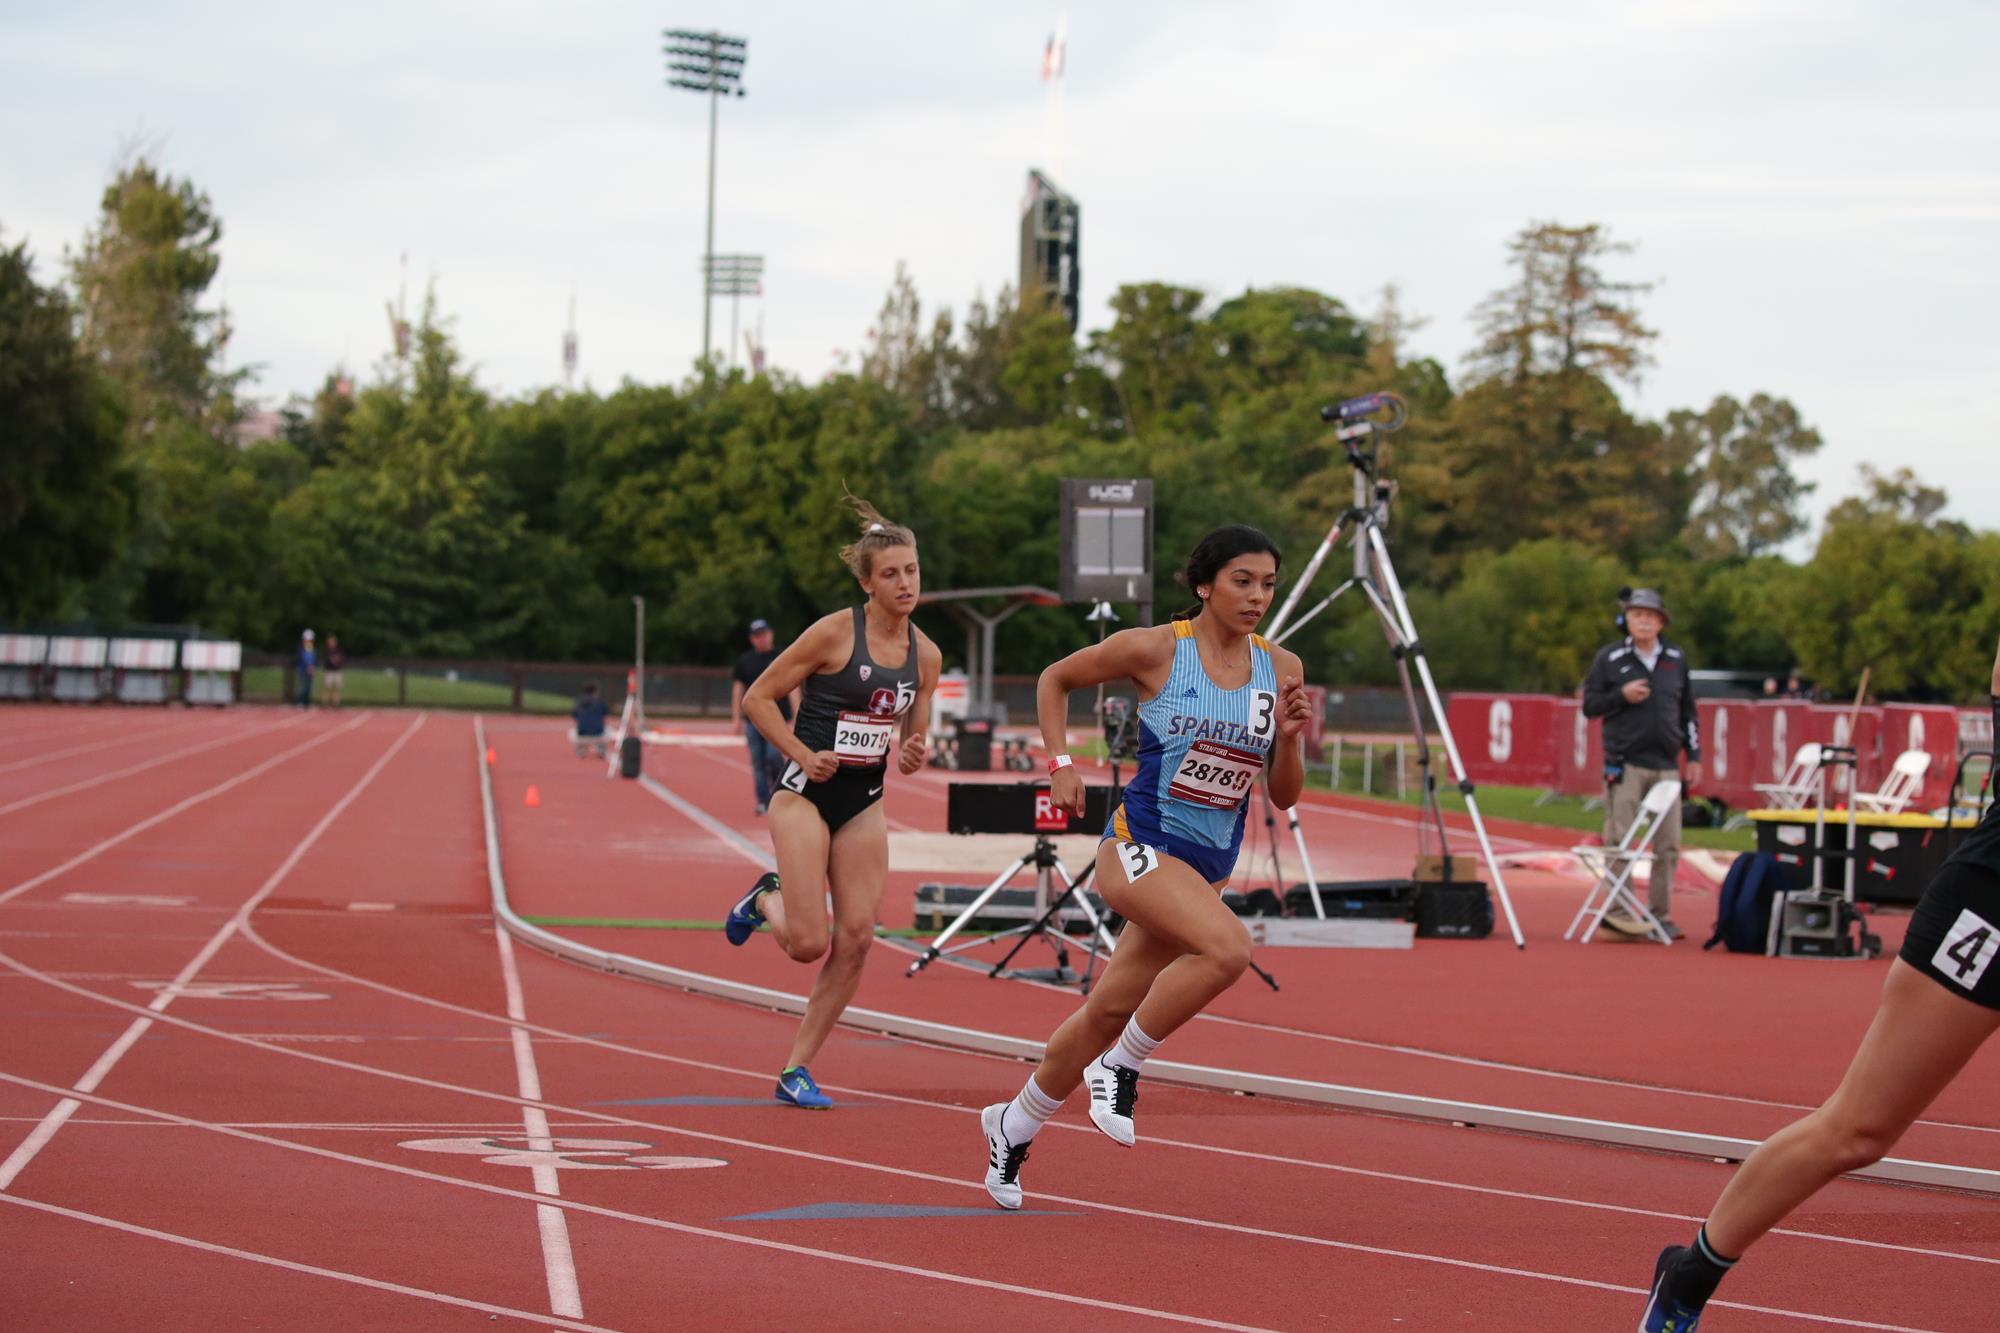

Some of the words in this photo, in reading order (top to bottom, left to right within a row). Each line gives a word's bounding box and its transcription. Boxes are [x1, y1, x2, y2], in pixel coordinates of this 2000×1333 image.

[1254, 692, 1275, 736] 3
[1199, 743, 1229, 757] STANFORD
[1125, 842, 1149, 878] 3
[1946, 925, 1992, 980] 4
